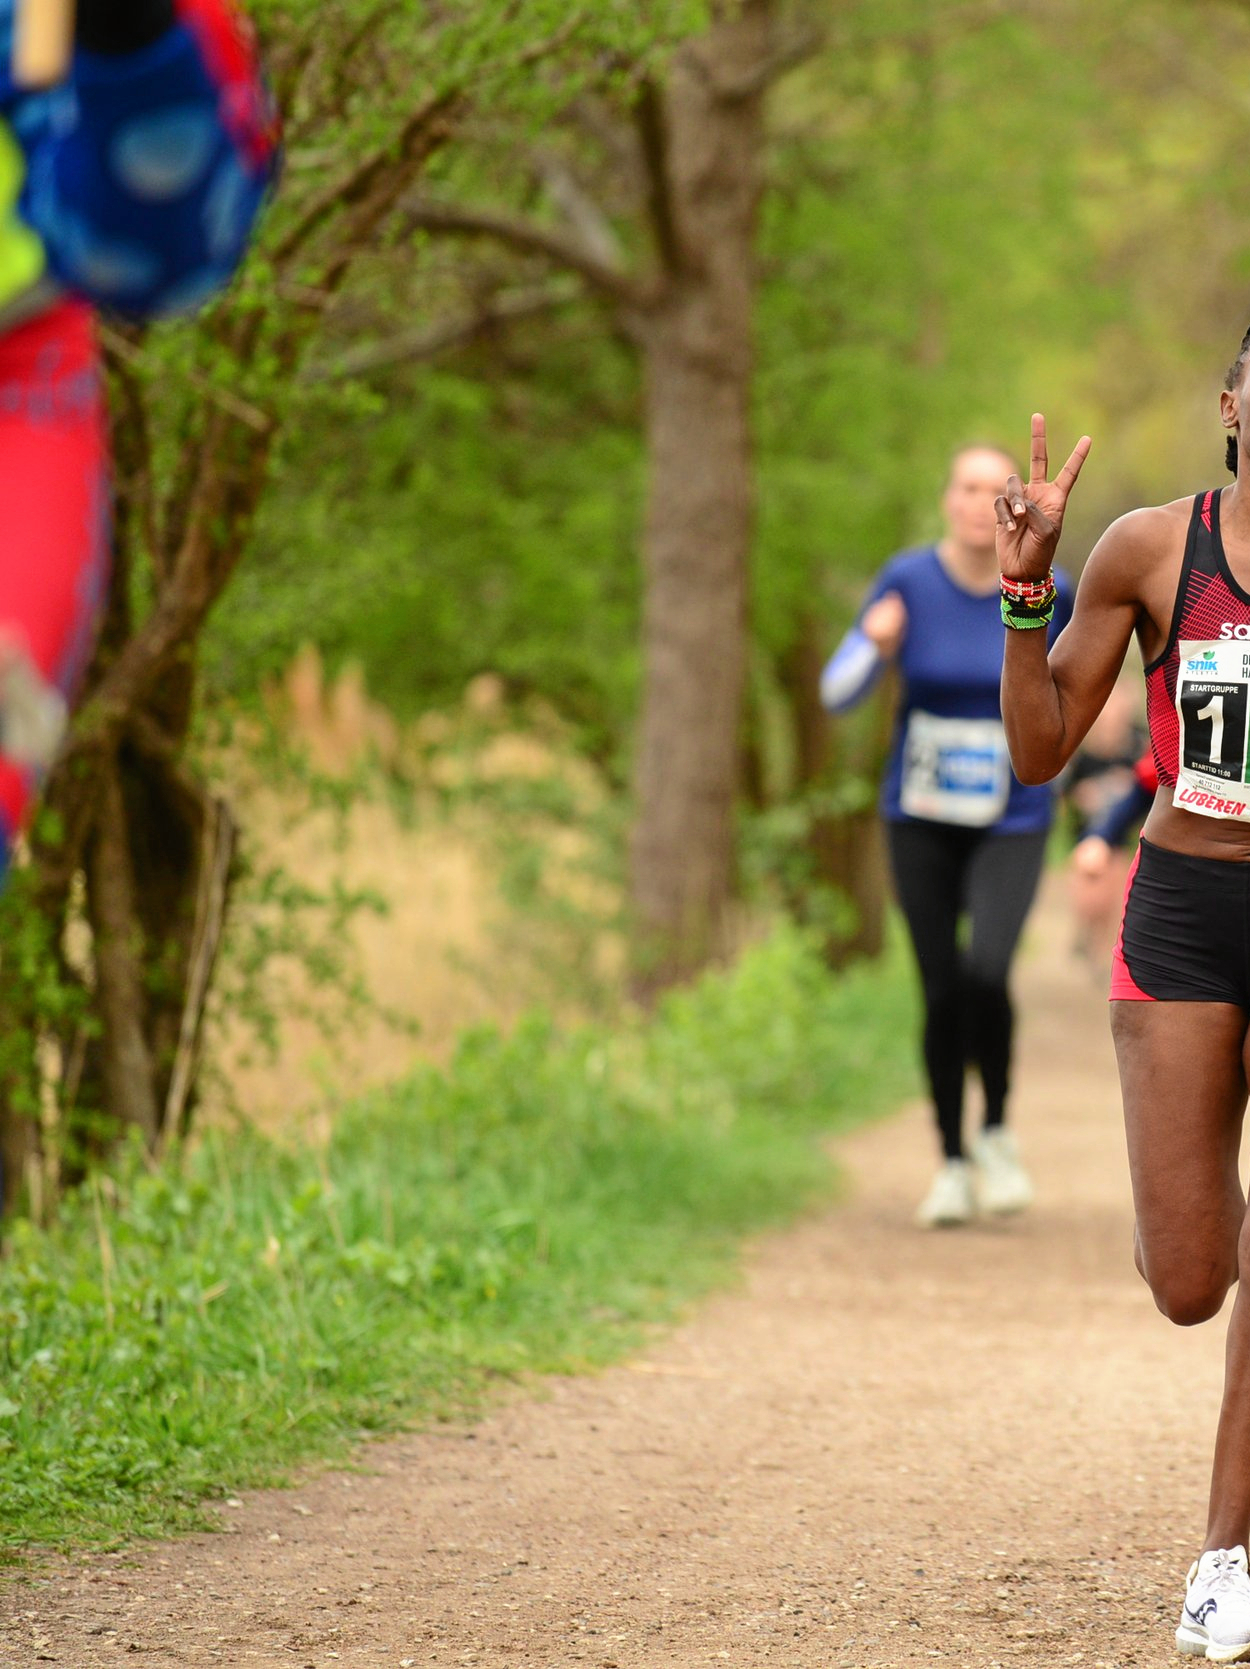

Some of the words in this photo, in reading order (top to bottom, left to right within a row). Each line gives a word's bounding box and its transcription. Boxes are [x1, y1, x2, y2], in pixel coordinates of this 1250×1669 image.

[1190, 684, 1239, 694] STARTGRUPPE
[1197, 695, 1224, 764] 1
[1192, 762, 1216, 773] STARTTID
[1217, 769, 1231, 777] 11:00
[1179, 788, 1246, 816] LØBEREN
